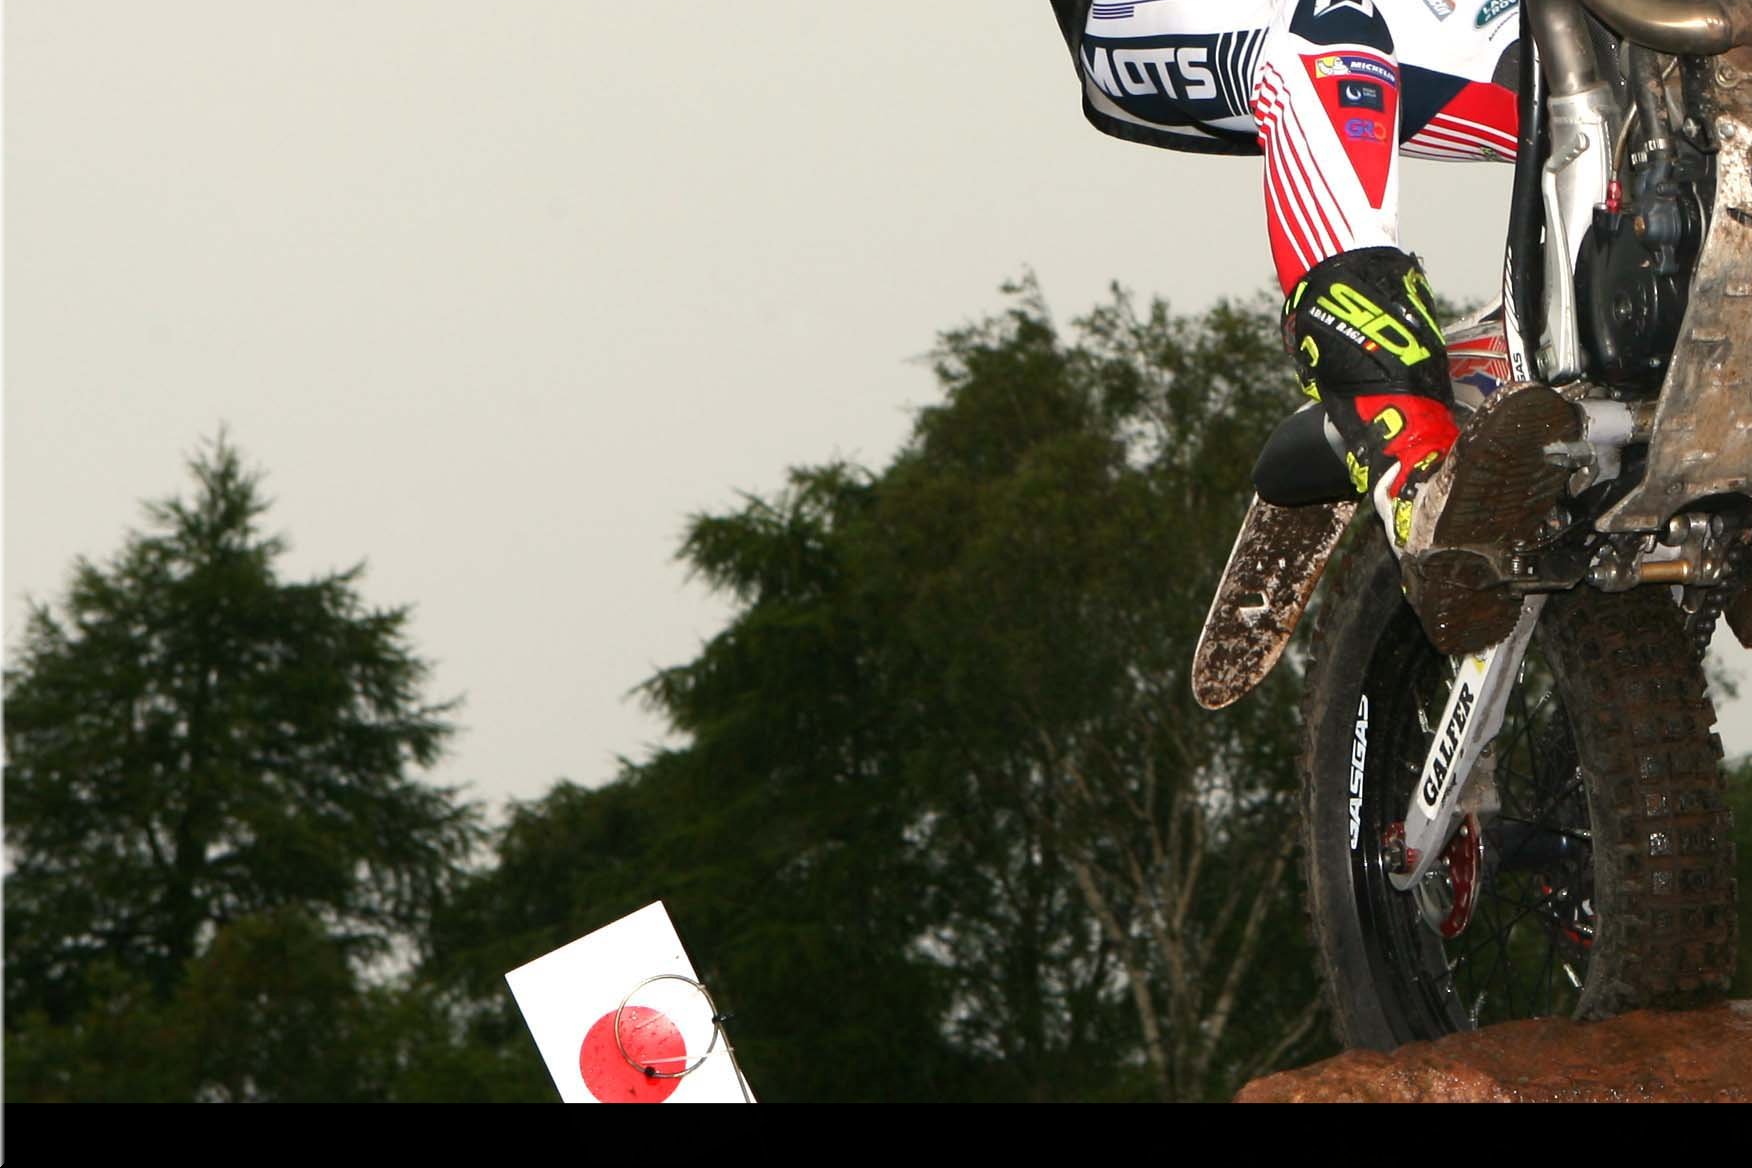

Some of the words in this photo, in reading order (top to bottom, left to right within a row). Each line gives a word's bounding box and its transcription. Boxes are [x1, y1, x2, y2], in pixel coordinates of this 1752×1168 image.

[1081, 46, 1218, 100] MOTS
[1350, 60, 1396, 83] MICHELIN
[1423, 681, 1474, 807] GALFER
